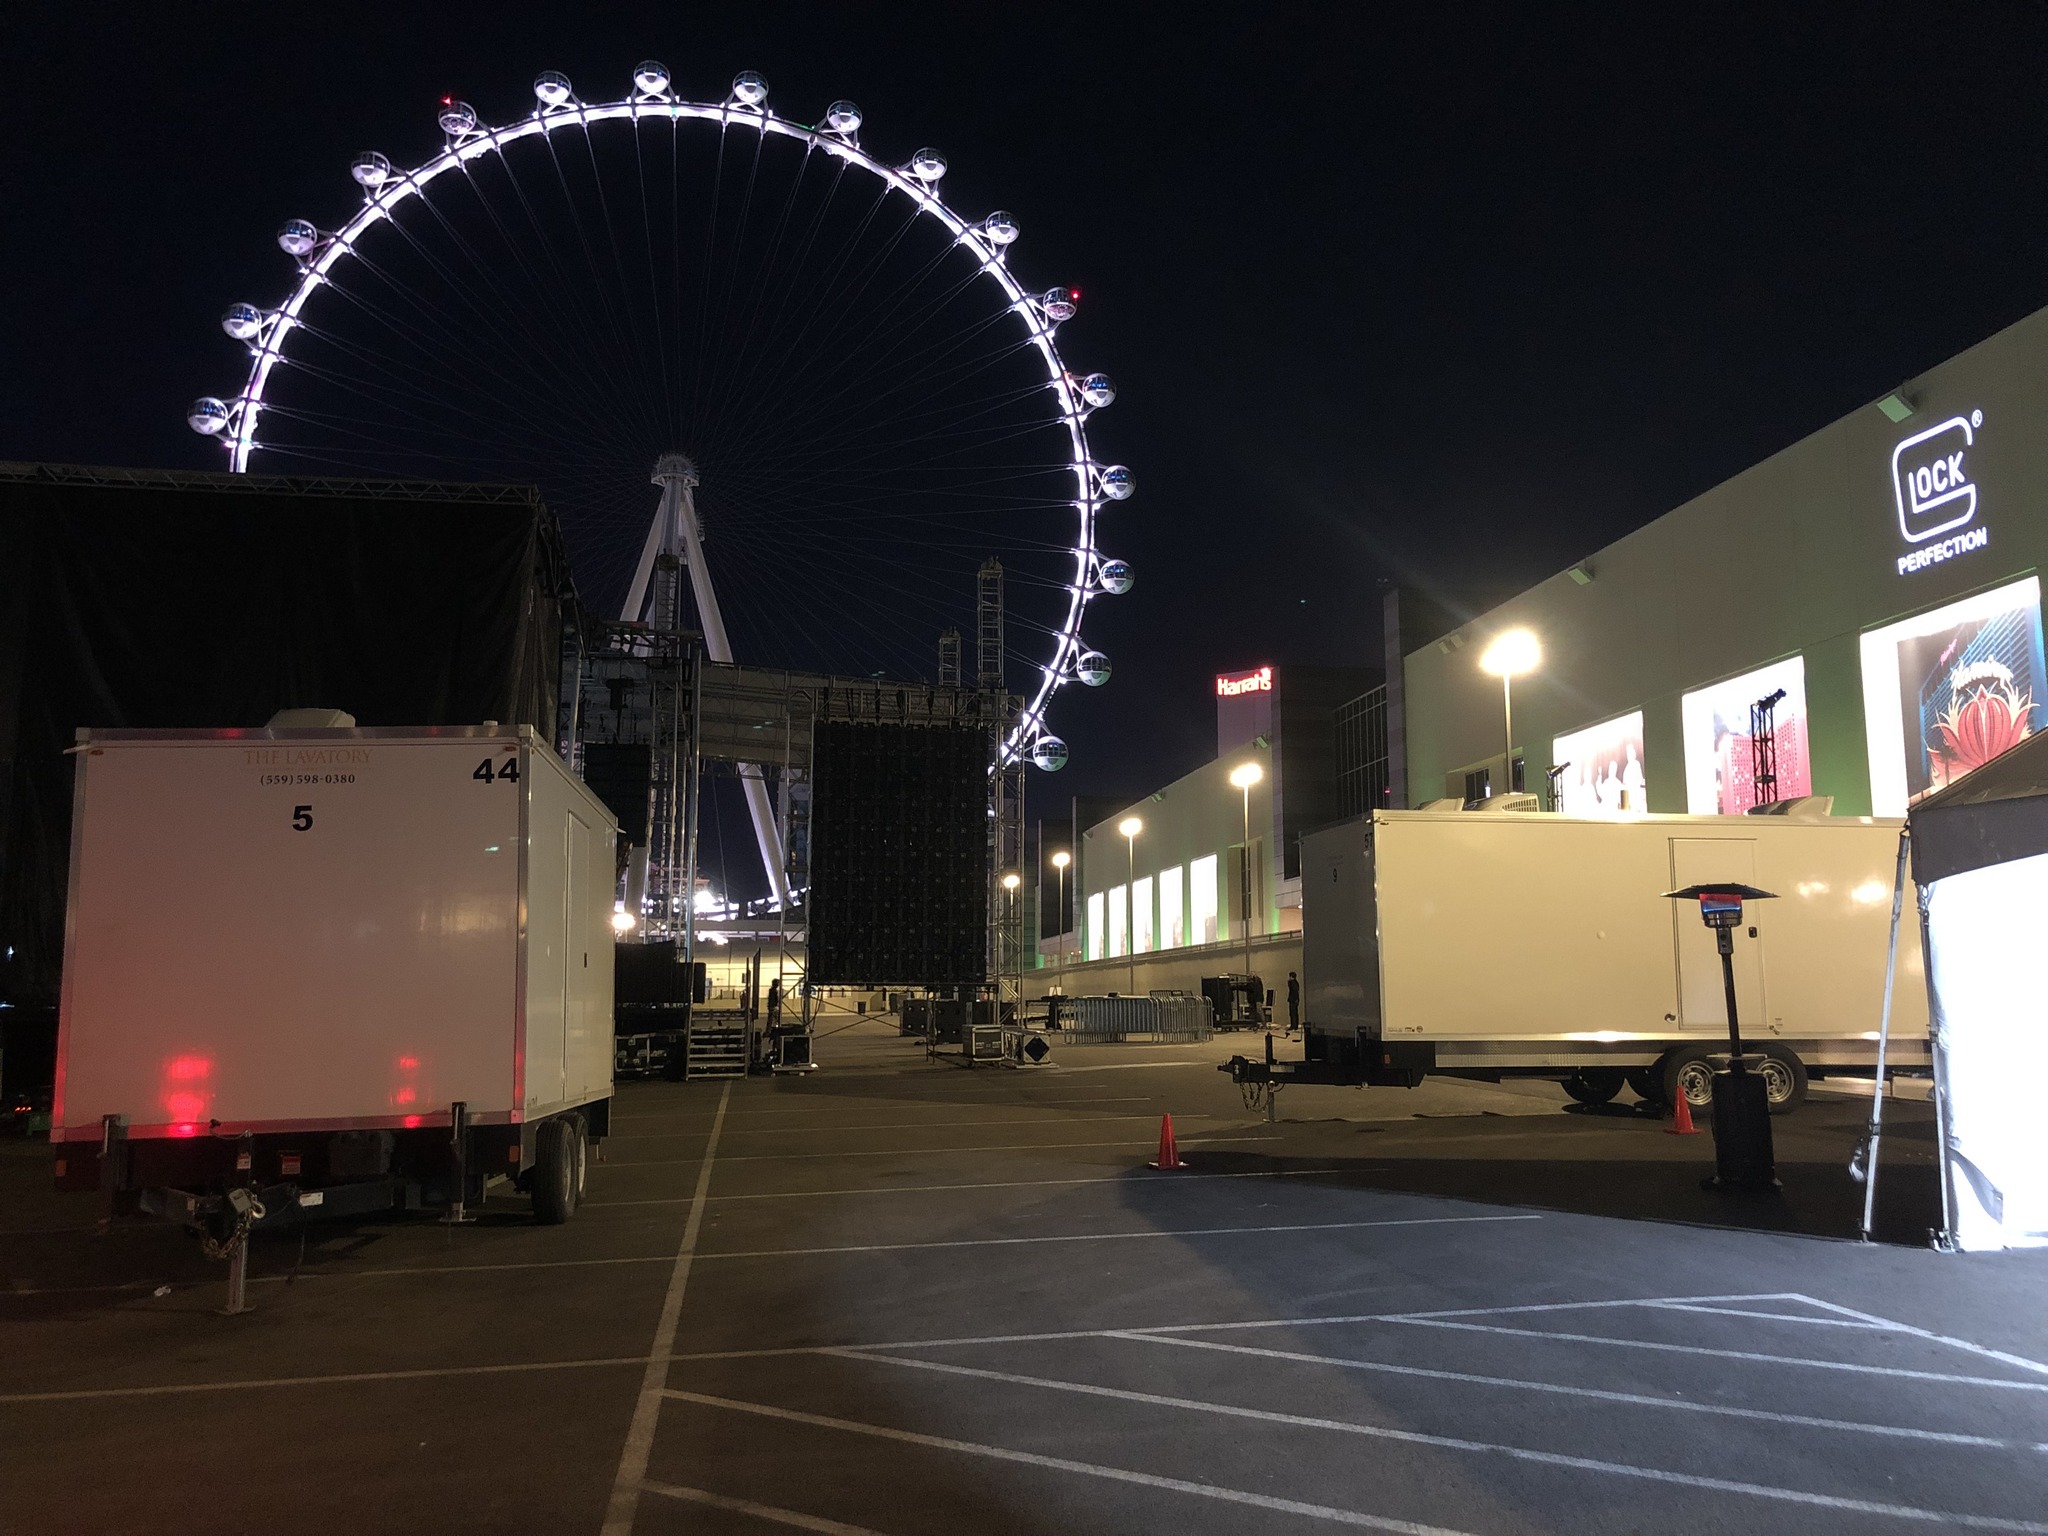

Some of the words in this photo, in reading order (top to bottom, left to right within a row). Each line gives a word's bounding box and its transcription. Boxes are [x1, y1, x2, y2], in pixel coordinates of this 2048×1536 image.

[1897, 526, 1988, 576] PERFECTION
[244, 749, 280, 764] THE
[286, 749, 373, 764] LAVATORY
[472, 757, 520, 784] 44
[292, 805, 314, 832] 5
